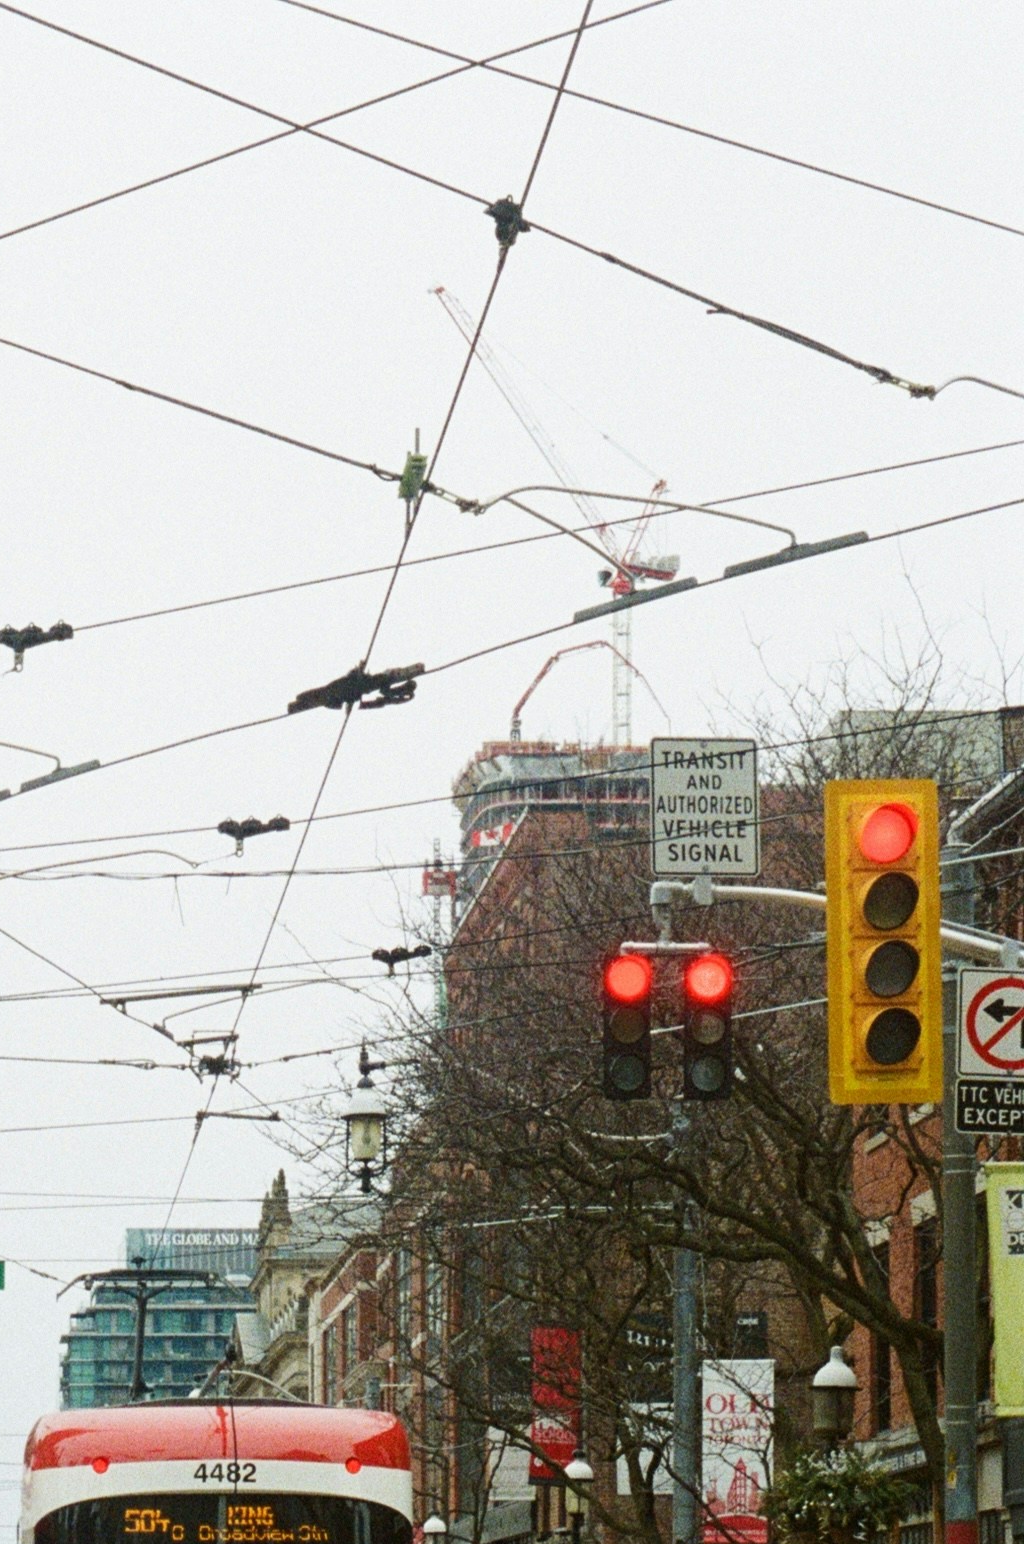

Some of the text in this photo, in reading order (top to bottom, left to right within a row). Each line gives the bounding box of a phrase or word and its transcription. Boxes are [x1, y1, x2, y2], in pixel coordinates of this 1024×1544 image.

[661, 751, 746, 770] TRANSIT
[686, 774, 723, 790] AND
[656, 795, 754, 815] AUTHORIZED
[662, 819, 748, 839] VEHICLE
[667, 843, 744, 863] SIGNAL
[960, 1086, 1024, 1105] TTC VEH
[146, 1234, 170, 1246] THE
[172, 1233, 211, 1246] GLOBE
[212, 1233, 239, 1246] AND
[705, 1393, 770, 1414] OLD
[708, 1417, 770, 1433] TOWN
[193, 1463, 257, 1483] 4482
